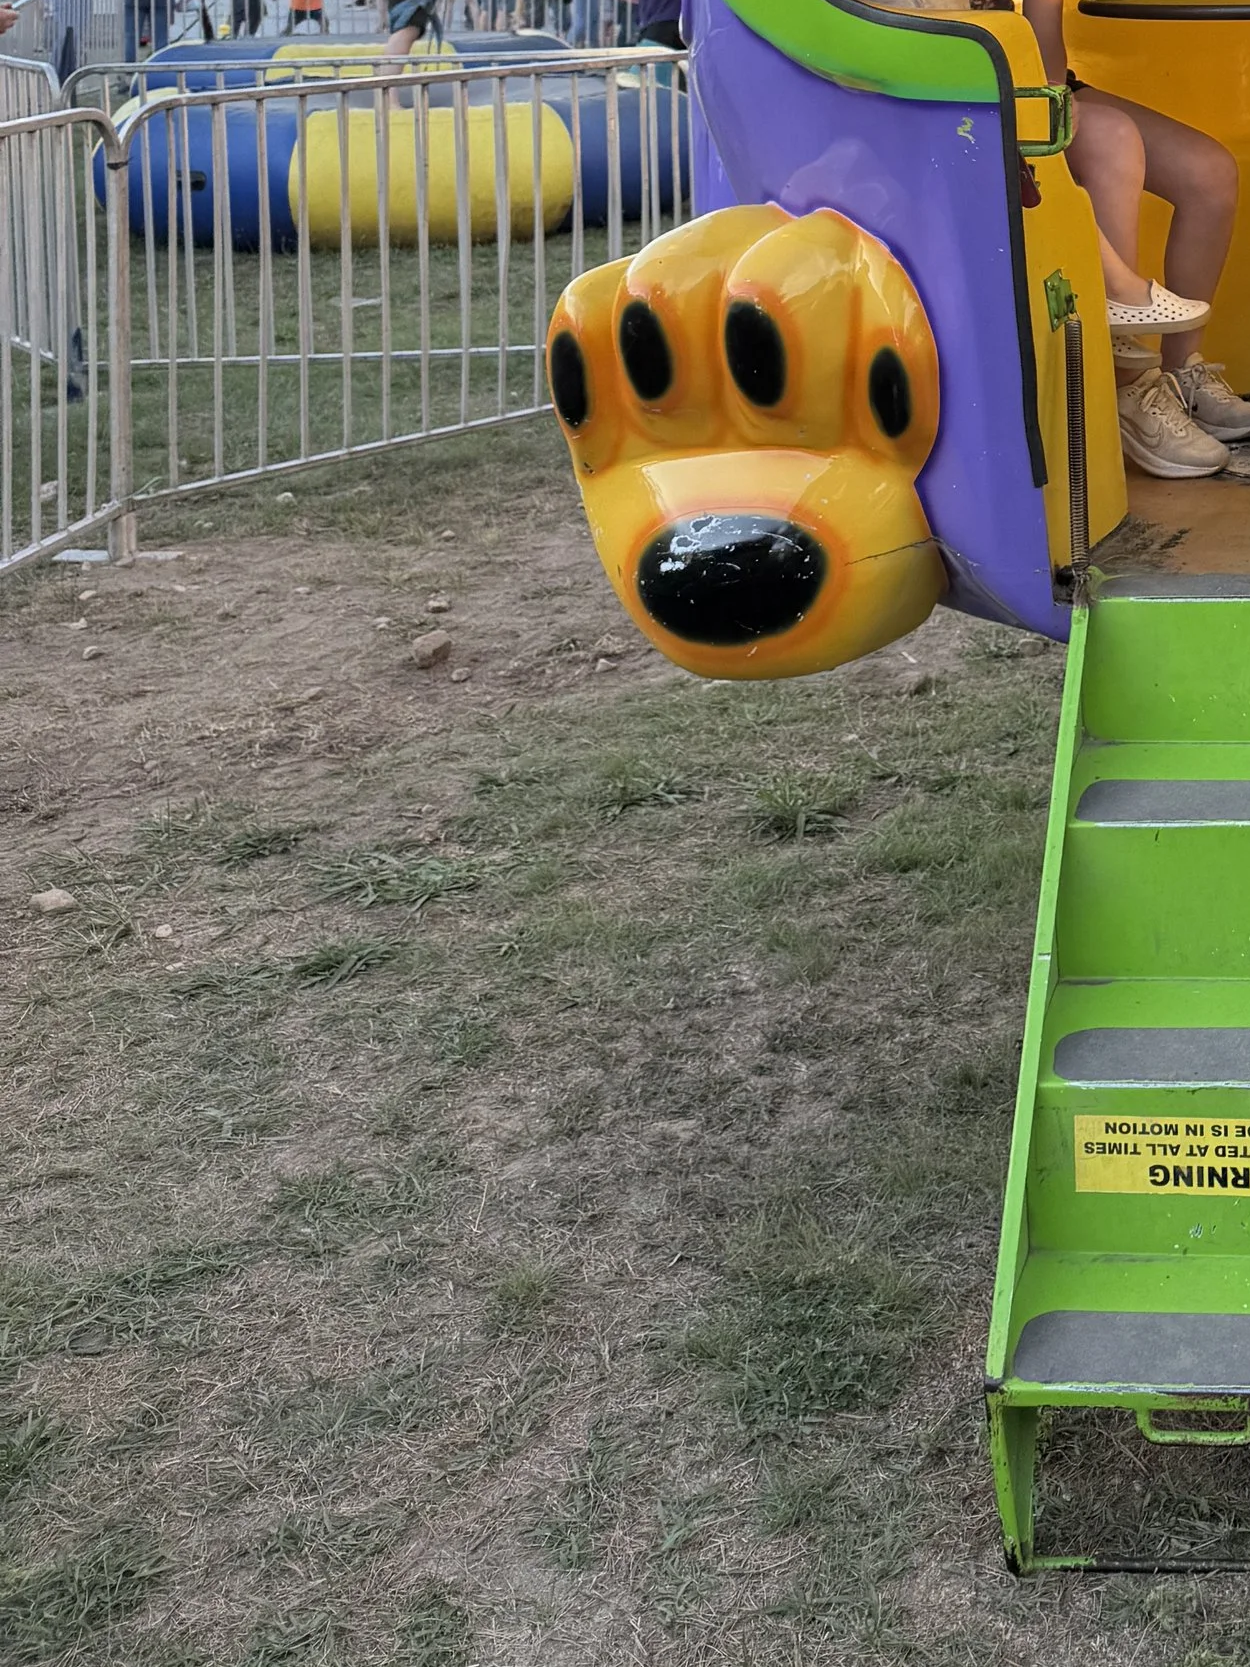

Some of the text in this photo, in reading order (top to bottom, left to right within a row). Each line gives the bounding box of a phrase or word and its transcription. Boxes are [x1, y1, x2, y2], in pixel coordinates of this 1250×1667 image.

[1105, 1123, 1178, 1135] MOTION
[1186, 1125, 1204, 1136] IN
[1211, 1125, 1228, 1137] IS
[1084, 1142, 1141, 1155] TIMES
[1146, 1144, 1180, 1156] ALL
[1186, 1145, 1209, 1157] AT
